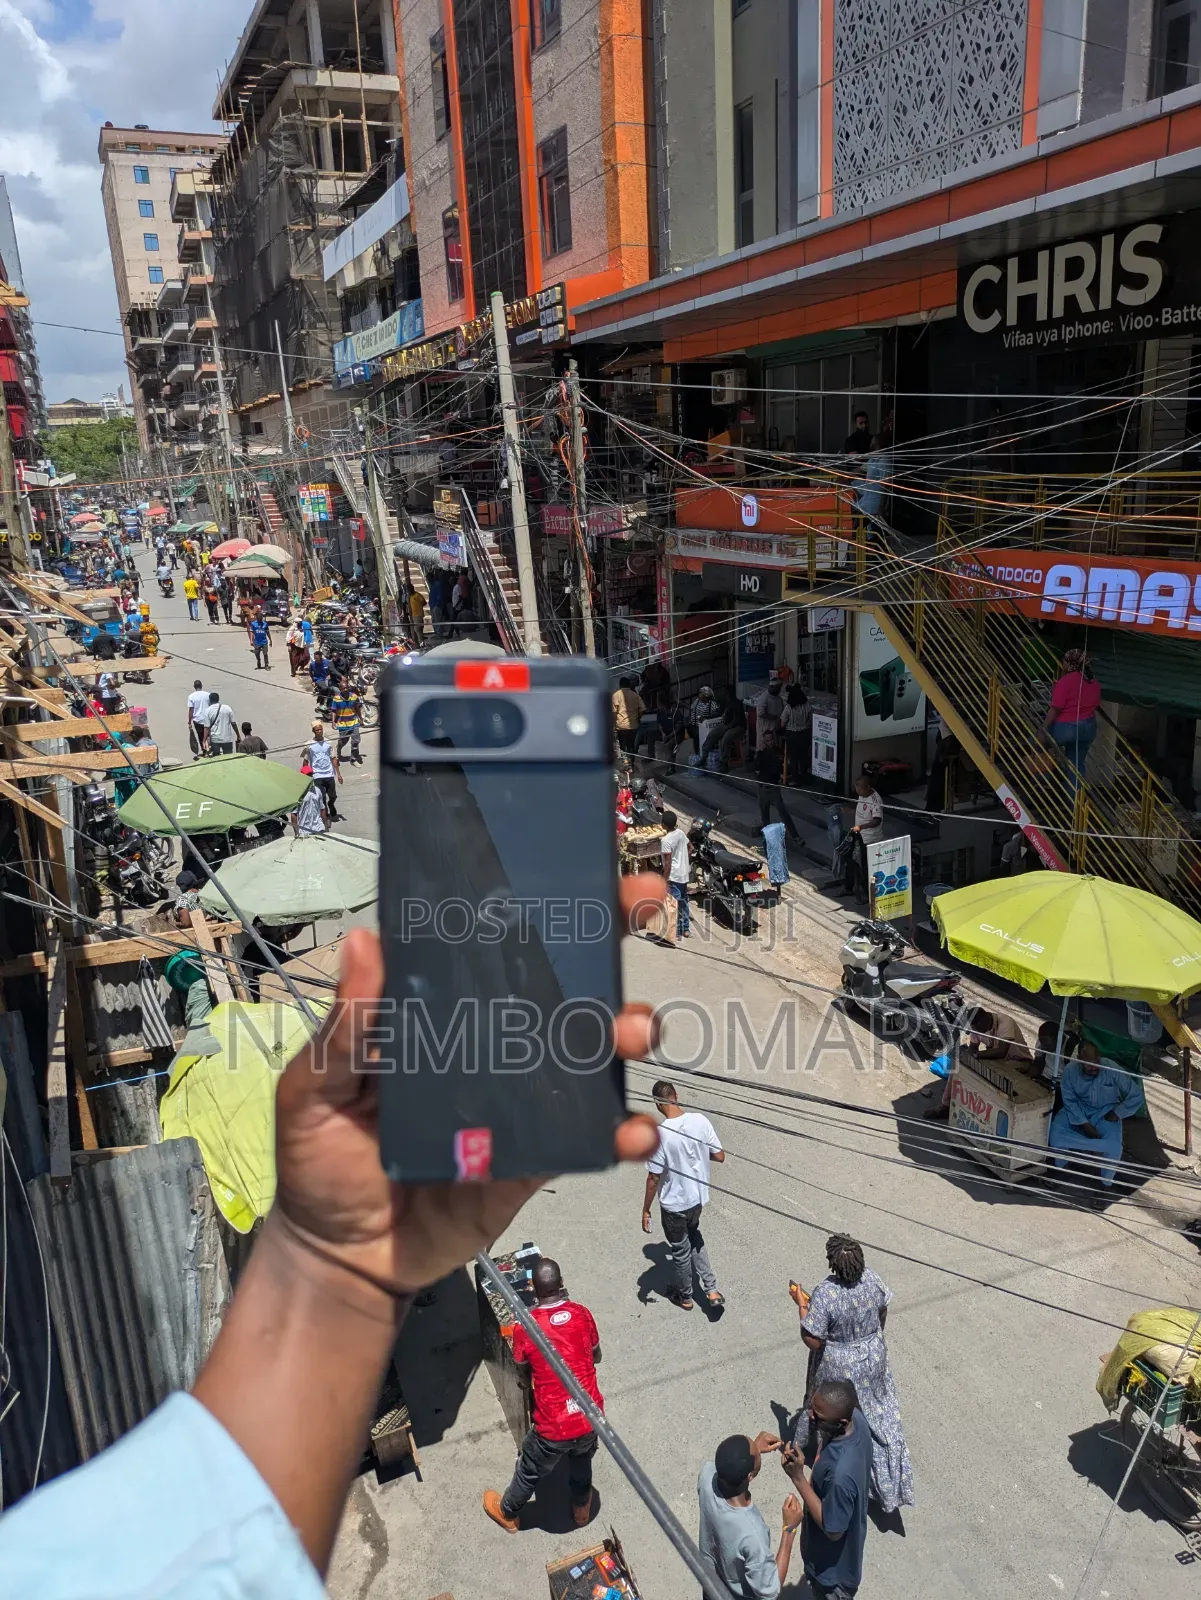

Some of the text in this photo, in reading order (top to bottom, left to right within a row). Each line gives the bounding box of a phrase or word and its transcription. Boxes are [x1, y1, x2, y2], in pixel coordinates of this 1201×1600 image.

[963, 223, 1164, 334] CHRIS
[1003, 330, 1034, 348] Vifaa
[1036, 328, 1058, 347] vya
[740, 574, 760, 593] HMD
[996, 566, 1043, 584] NDOGO
[1005, 801, 1020, 817] itel
[1030, 832, 1051, 862] Wauzaji
[979, 923, 1045, 954] CALUS
